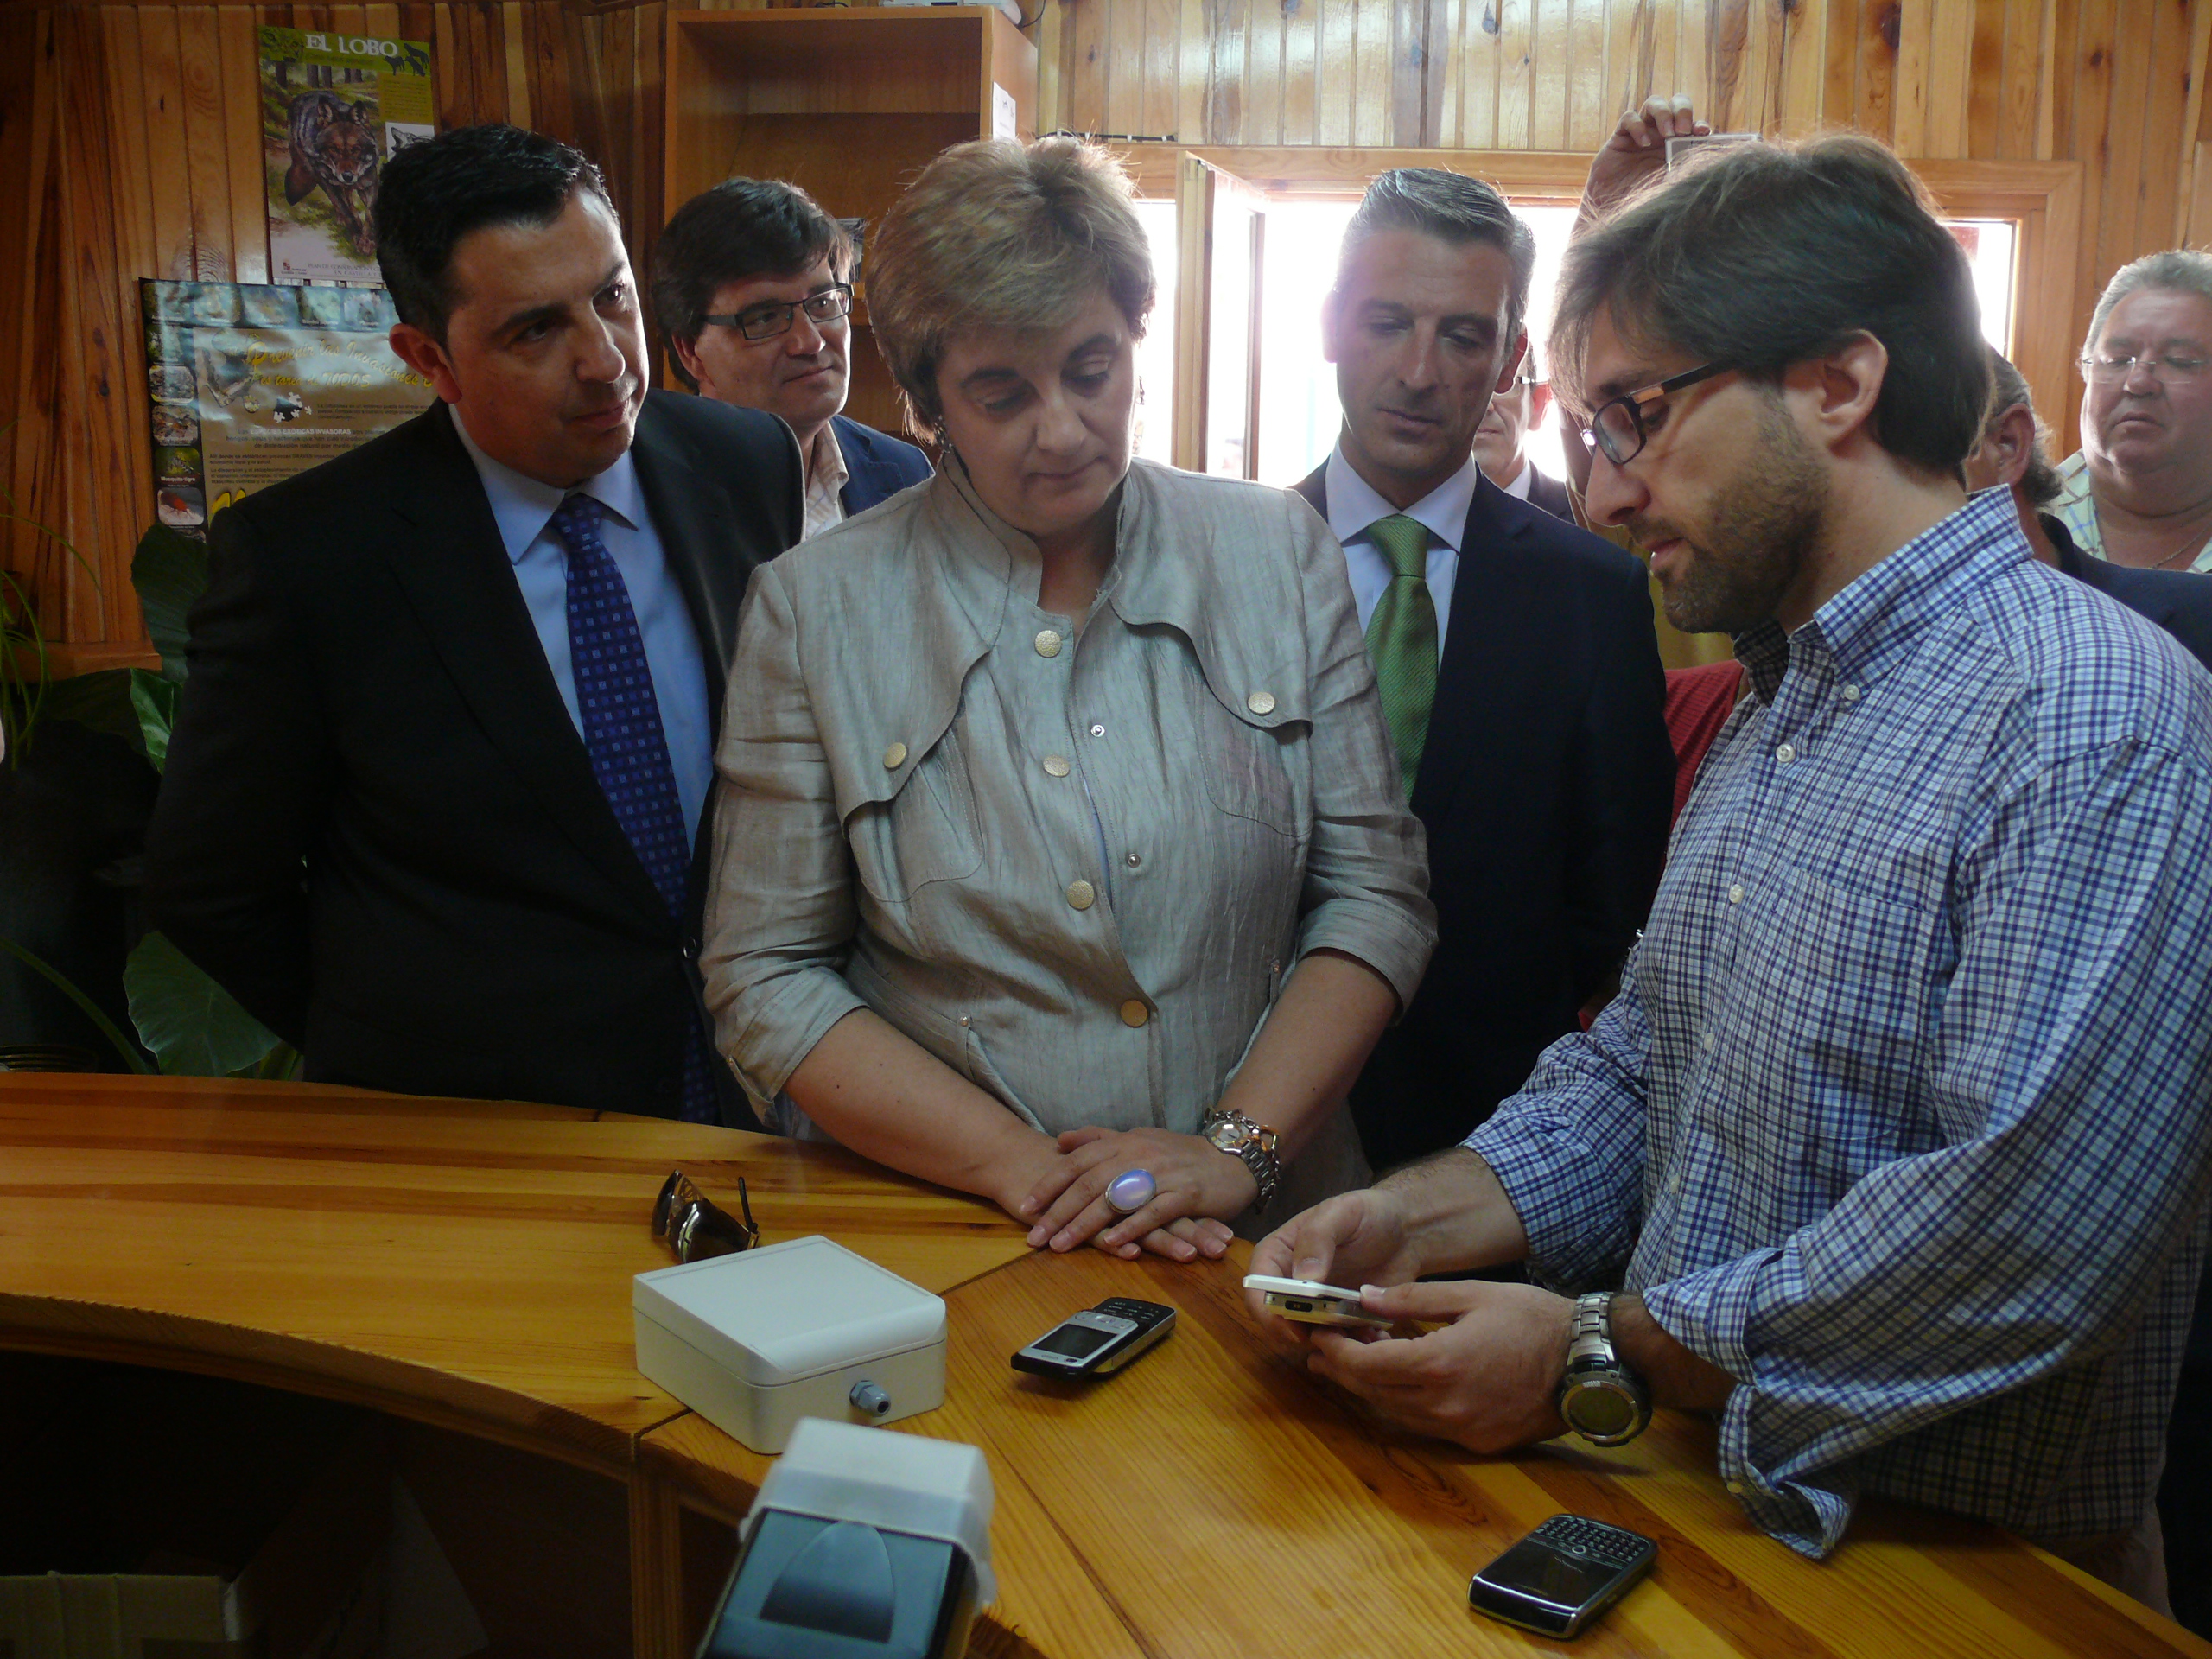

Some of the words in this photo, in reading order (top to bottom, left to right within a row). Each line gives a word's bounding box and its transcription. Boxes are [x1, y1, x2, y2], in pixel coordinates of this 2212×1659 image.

[305, 34, 332, 52] EL
[338, 36, 398, 57] LOBO
[319, 339, 340, 355] las
[346, 340, 419, 385] Invasiones
[322, 372, 371, 387] TODOS
